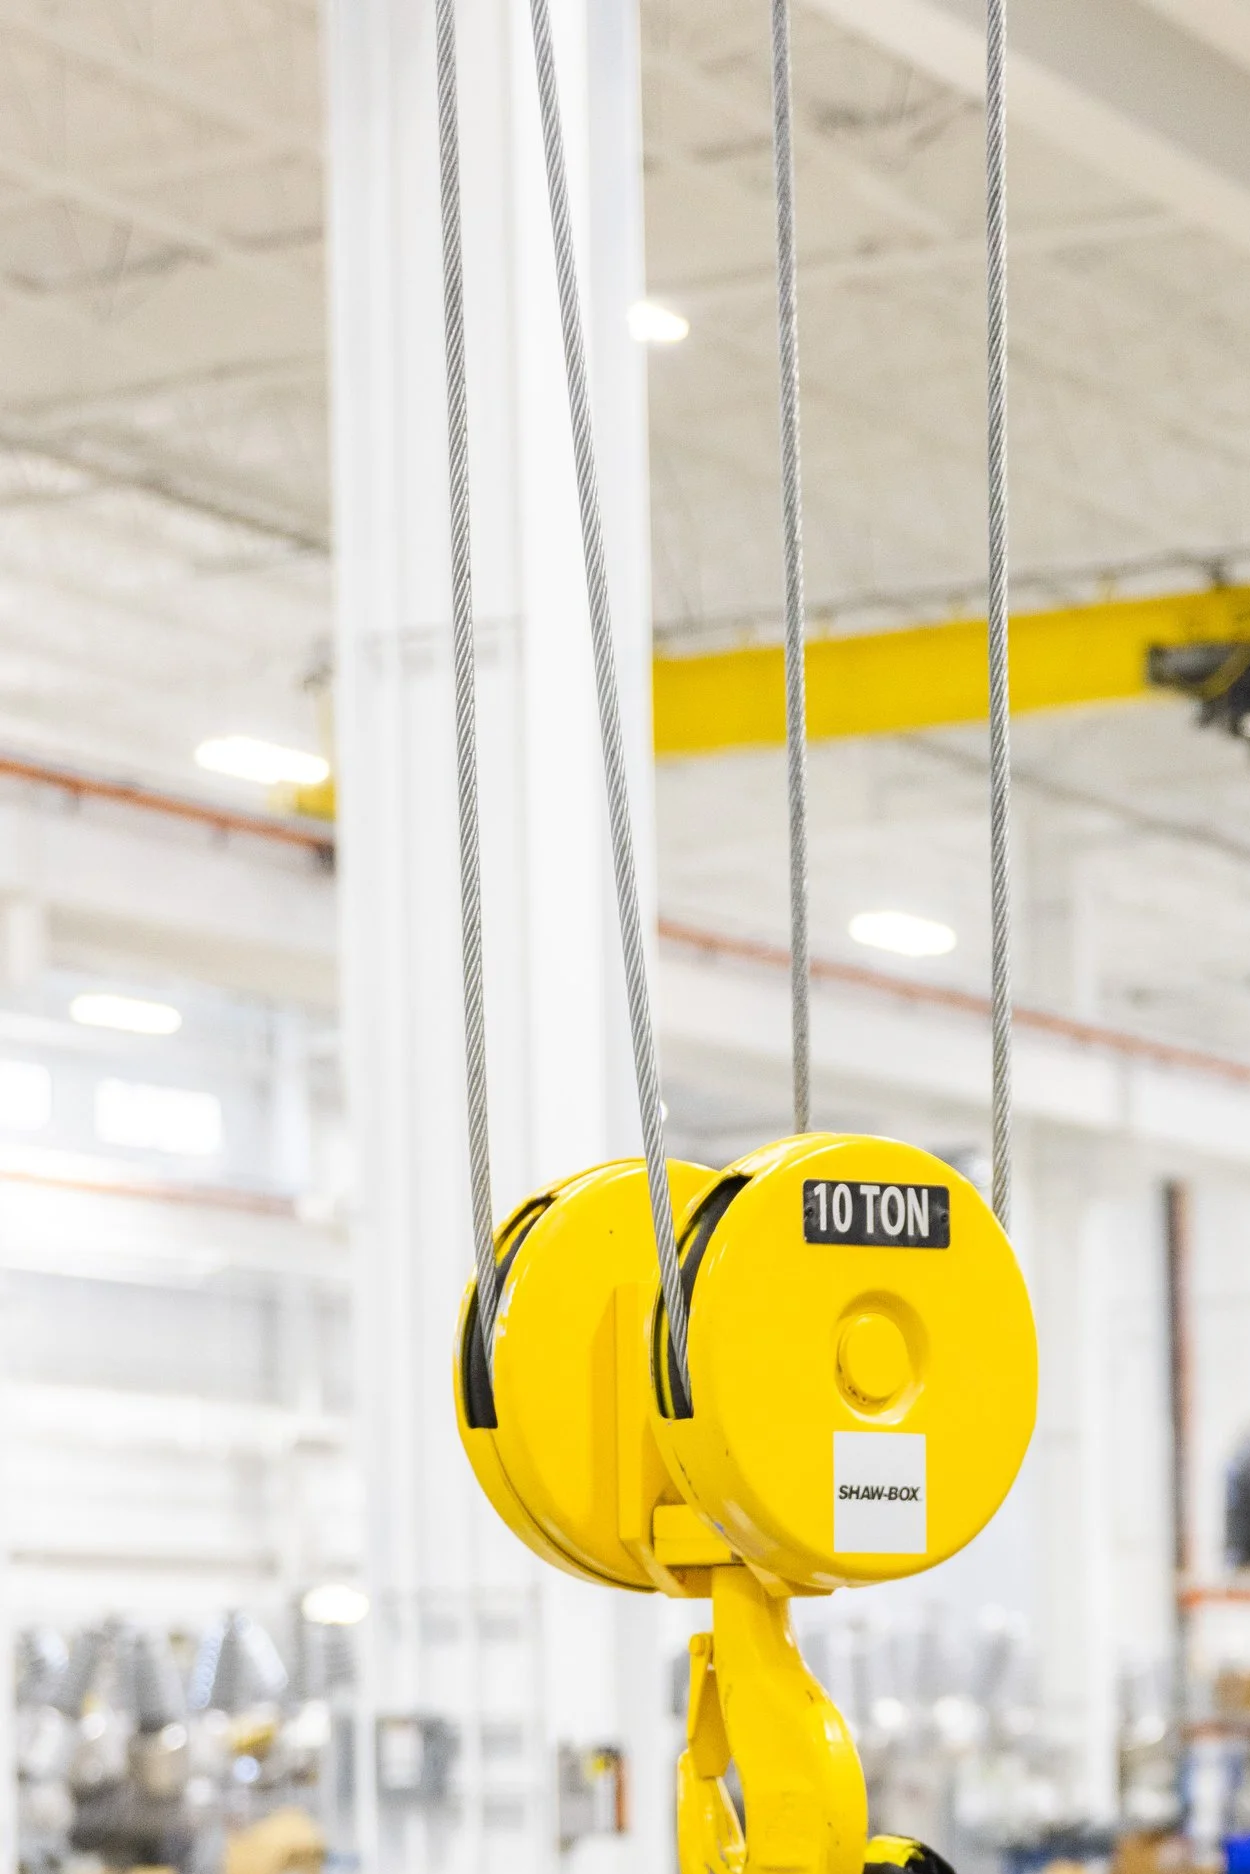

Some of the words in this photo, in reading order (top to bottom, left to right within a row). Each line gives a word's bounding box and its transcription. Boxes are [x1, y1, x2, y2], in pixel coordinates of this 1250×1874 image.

[813, 1182, 854, 1233] 10
[859, 1184, 930, 1238] TON
[838, 1485, 921, 1501] SHAW-BOX
